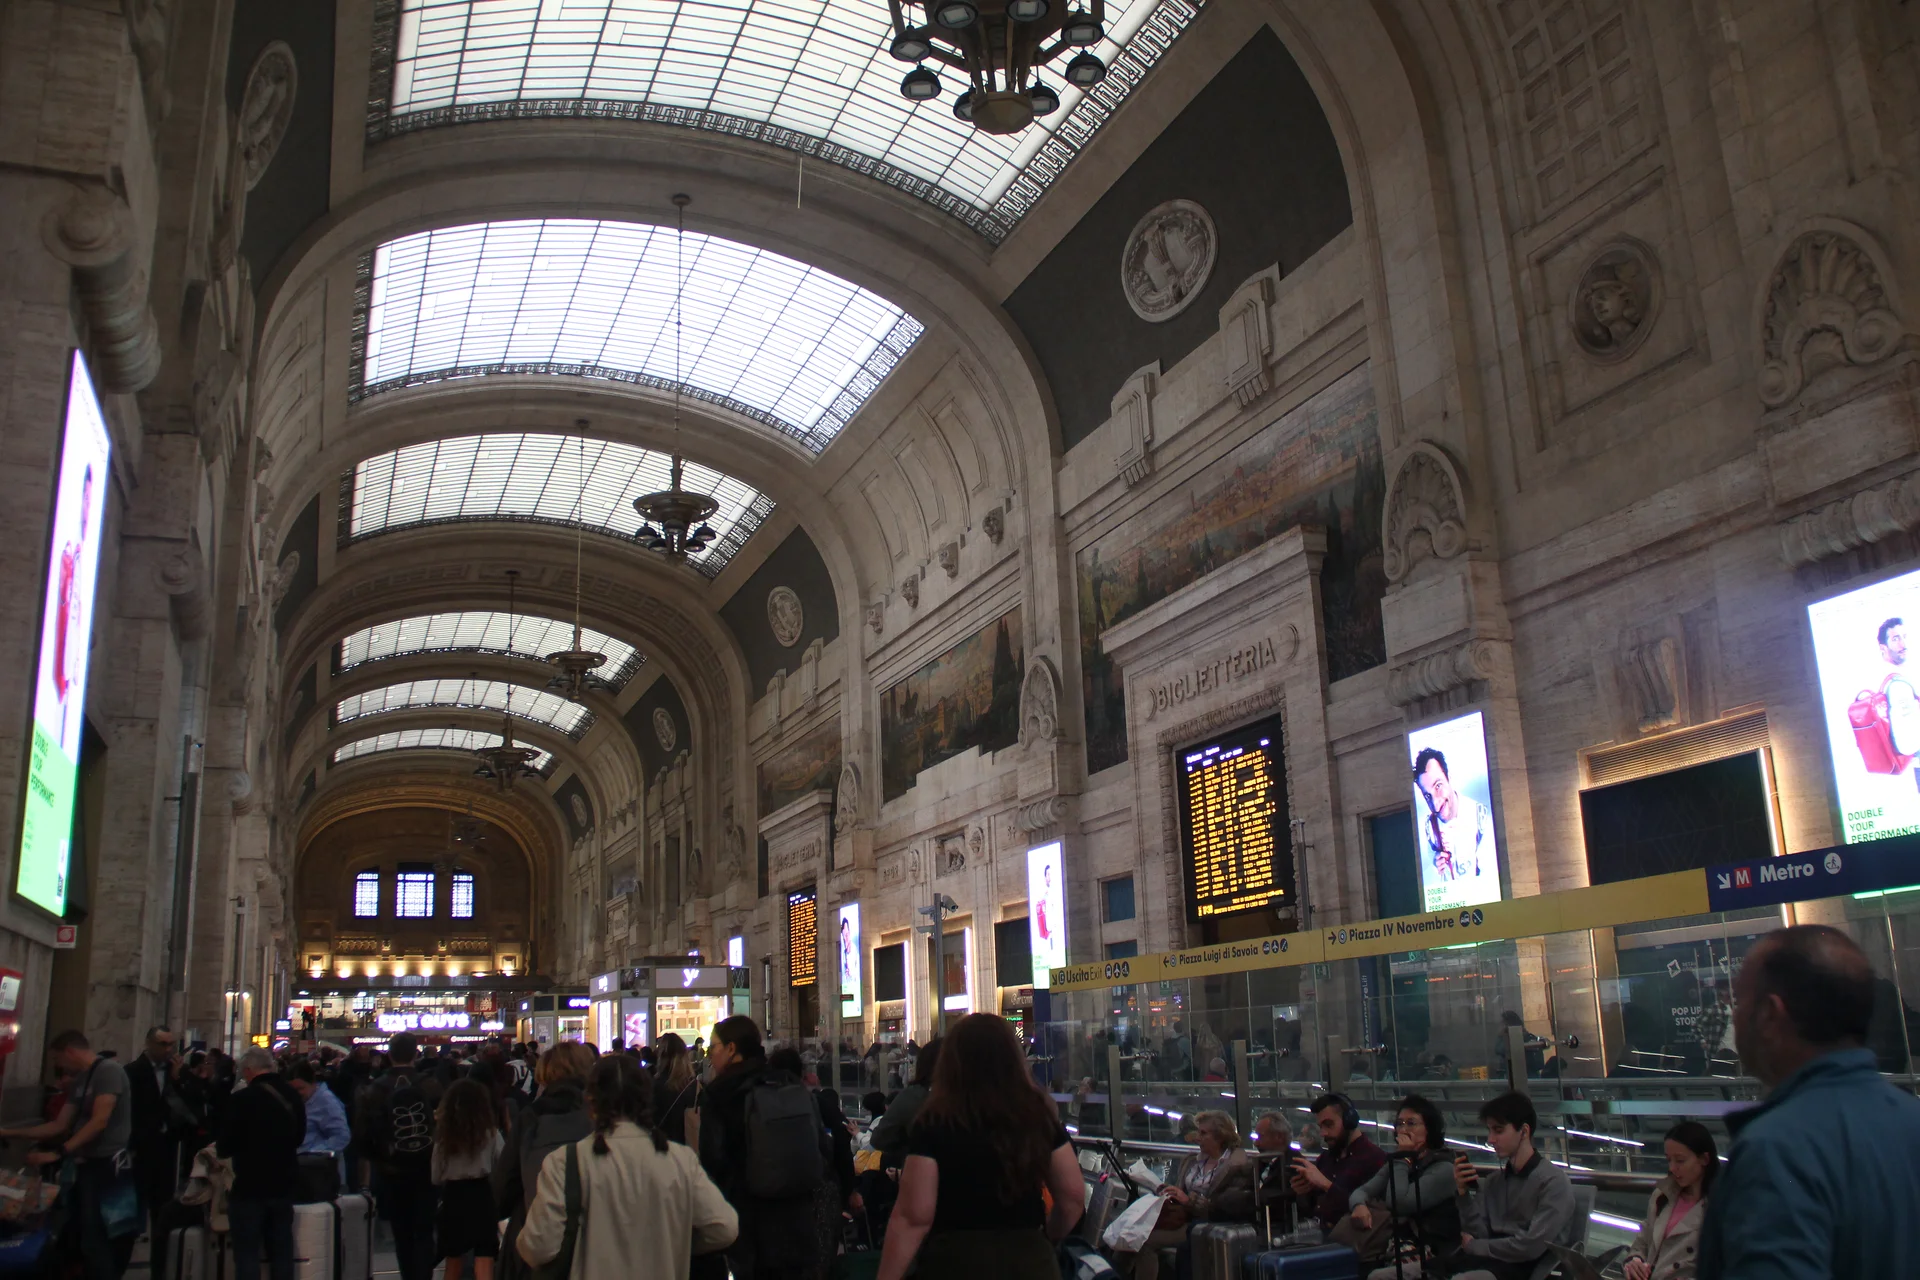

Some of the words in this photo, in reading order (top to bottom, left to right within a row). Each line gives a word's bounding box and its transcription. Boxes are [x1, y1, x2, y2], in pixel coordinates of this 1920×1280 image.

[1847, 806, 1885, 823] DOUBLE
[1849, 820, 1875, 833] YOUR
[1736, 869, 1750, 886] M
[1760, 863, 1815, 883] Metro
[1427, 886, 1447, 896] DOUBLE
[1428, 896, 1442, 904] YOUR
[1349, 927, 1381, 942] Piazza
[1383, 923, 1394, 937] IV
[1397, 916, 1454, 936] Novembre
[1179, 953, 1202, 965] Piazza
[1203, 950, 1221, 964] Luigi
[1223, 948, 1231, 959] di
[1232, 944, 1259, 958] Savoia
[1066, 969, 1090, 983] Uscita
[1090, 966, 1103, 981] Exit
[1671, 1006, 1689, 1016] POP
[1690, 1006, 1702, 1015] UP
[420, 1013, 470, 1028] GUYS
[1675, 1016, 1700, 1026] STOR
